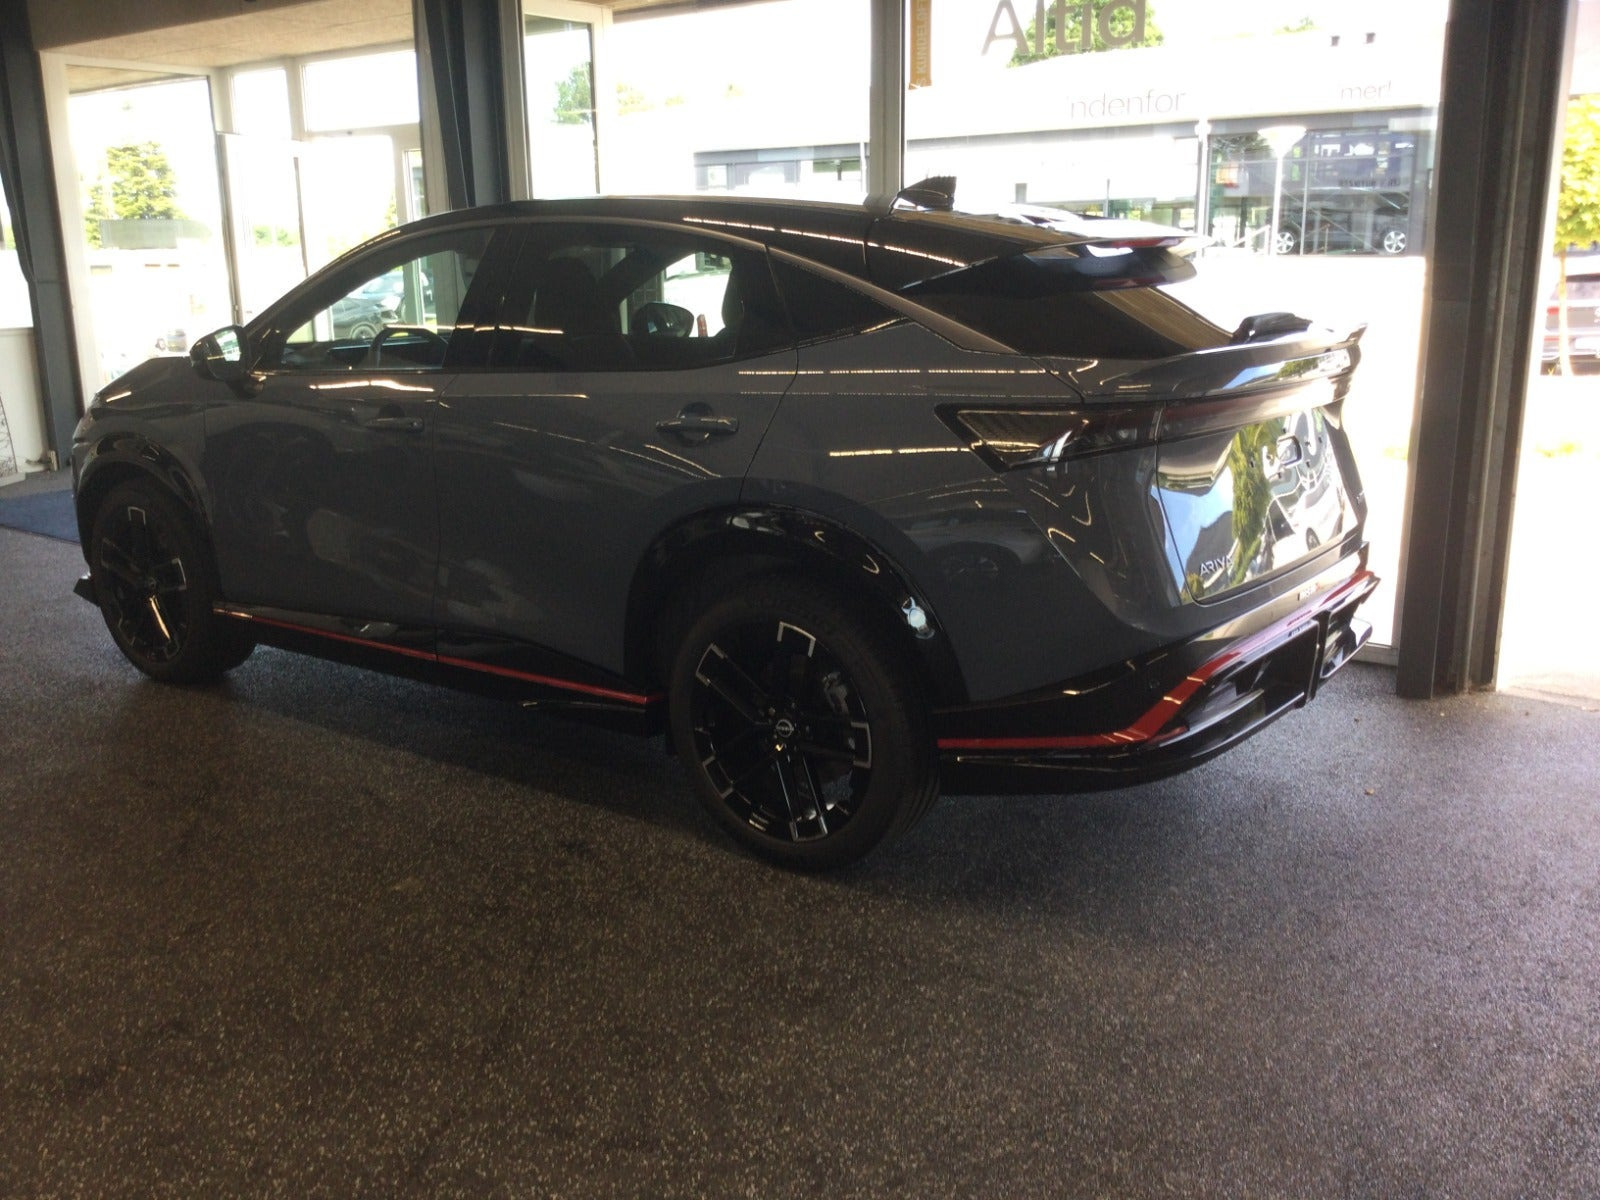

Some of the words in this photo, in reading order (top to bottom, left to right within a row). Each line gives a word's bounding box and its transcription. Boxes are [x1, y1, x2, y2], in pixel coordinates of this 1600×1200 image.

[981, 0, 1147, 56] Altid
[1067, 88, 1187, 118] ndenfor
[1200, 556, 1234, 576] ARIYA
